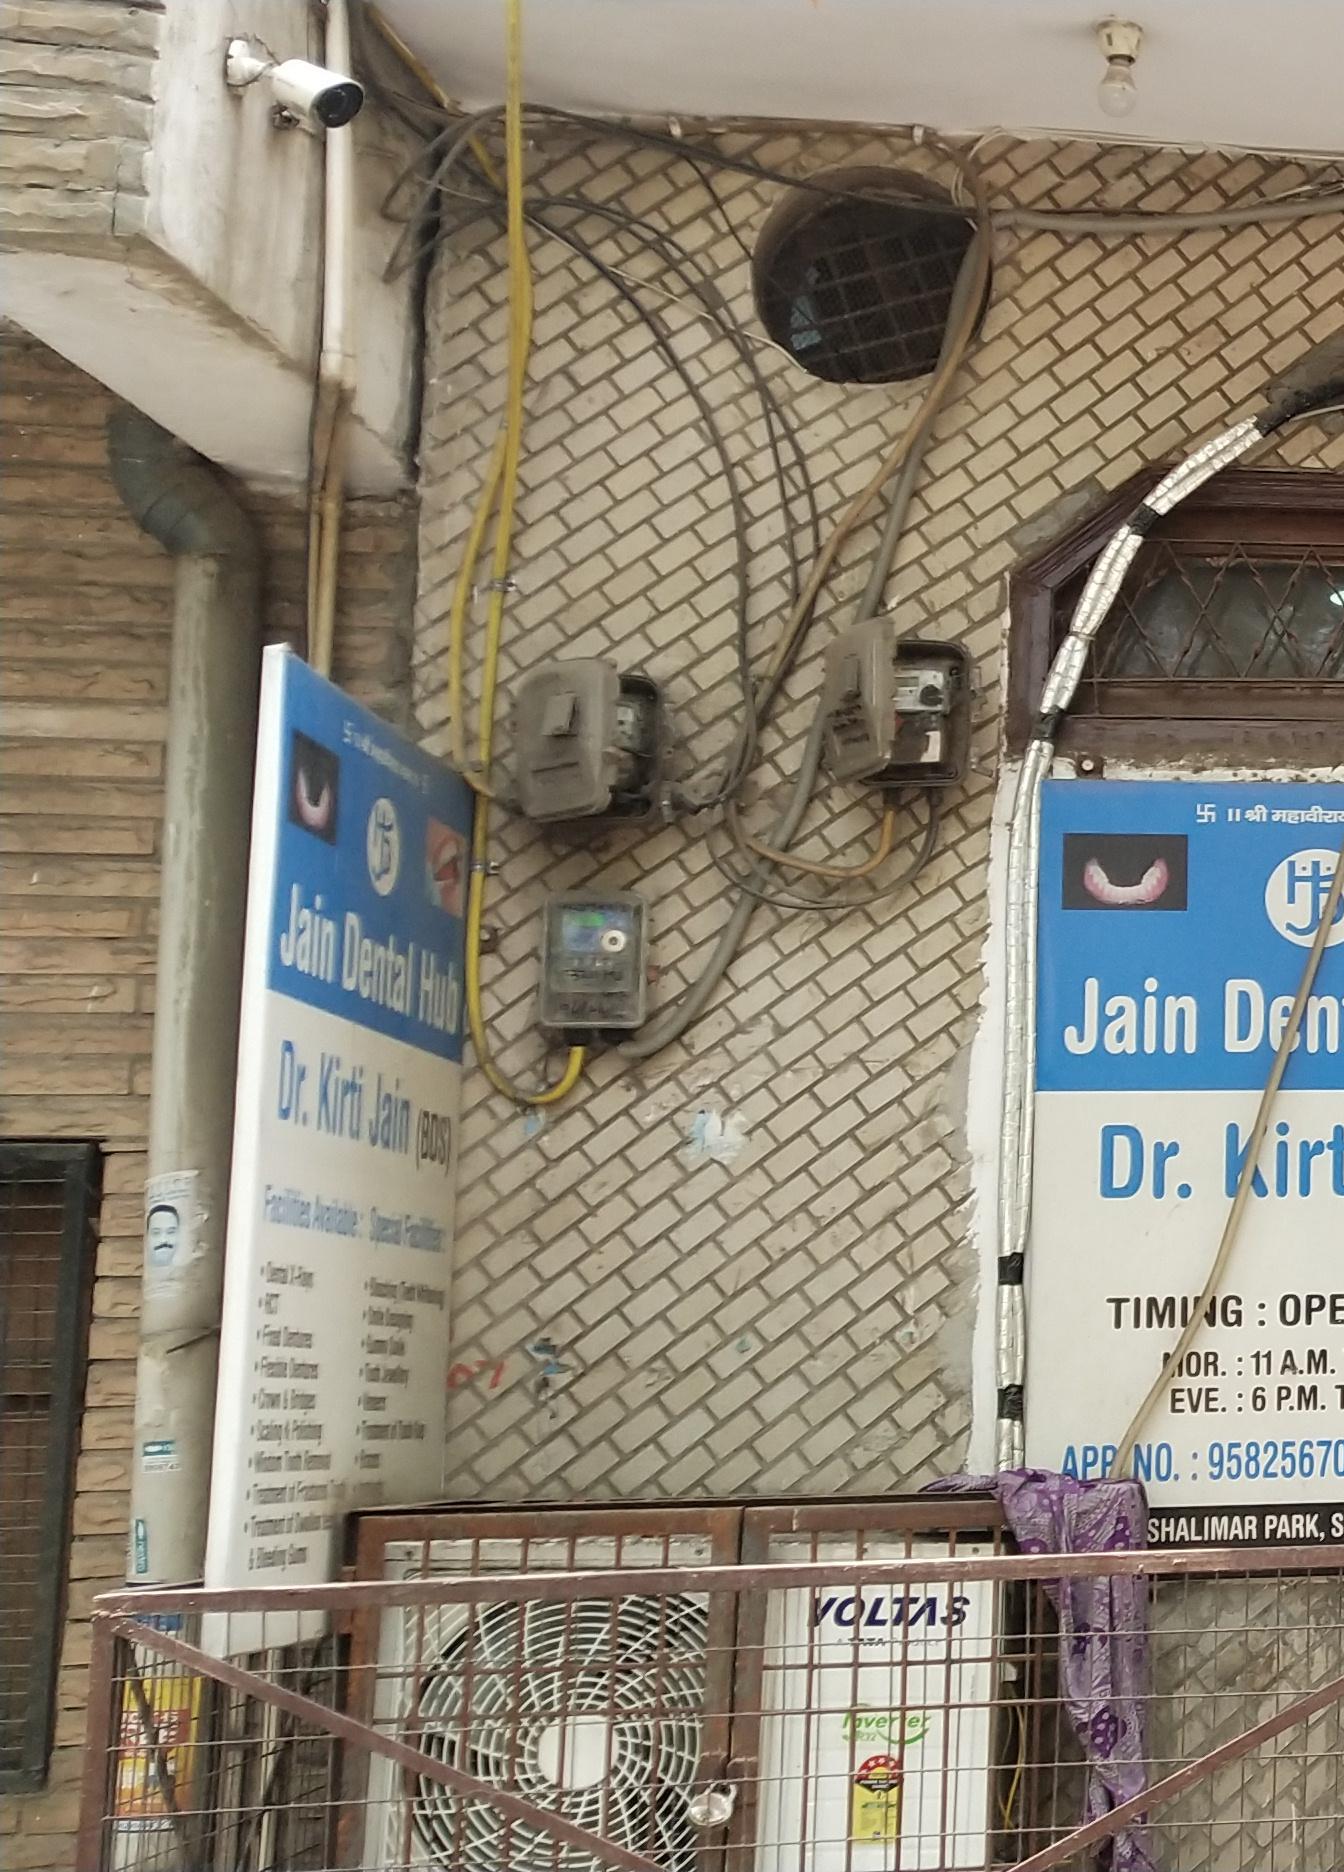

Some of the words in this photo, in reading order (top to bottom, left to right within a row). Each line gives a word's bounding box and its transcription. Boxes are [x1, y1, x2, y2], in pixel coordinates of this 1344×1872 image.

[1244, 805, 1267, 822] श्री
[281, 883, 335, 982] Jain
[342, 911, 413, 1016] Dental
[419, 949, 458, 1035] Hub
[1064, 977, 1197, 1054] Jain
[278, 1040, 307, 1128] Dr.
[317, 1052, 363, 1141] Kirti
[369, 1073, 410, 1154] Jain
[416, 1108, 451, 1178] (BDS)
[1101, 1124, 1192, 1199] Dr.
[1107, 1294, 1242, 1329] TIMING
[1251, 1351, 1272, 1375] 11
[1280, 1349, 1336, 1376] A.M.
[1170, 1387, 1226, 1413] EVE.
[1252, 1386, 1266, 1410] 6
[1276, 1385, 1325, 1411] P.M.
[1133, 1443, 1179, 1482] NO.
[1148, 1515, 1256, 1543] SHALIMAR
[1264, 1513, 1325, 1542] PARK,
[807, 1597, 970, 1627] VOLTAS
[843, 1711, 932, 1730] Inverer
